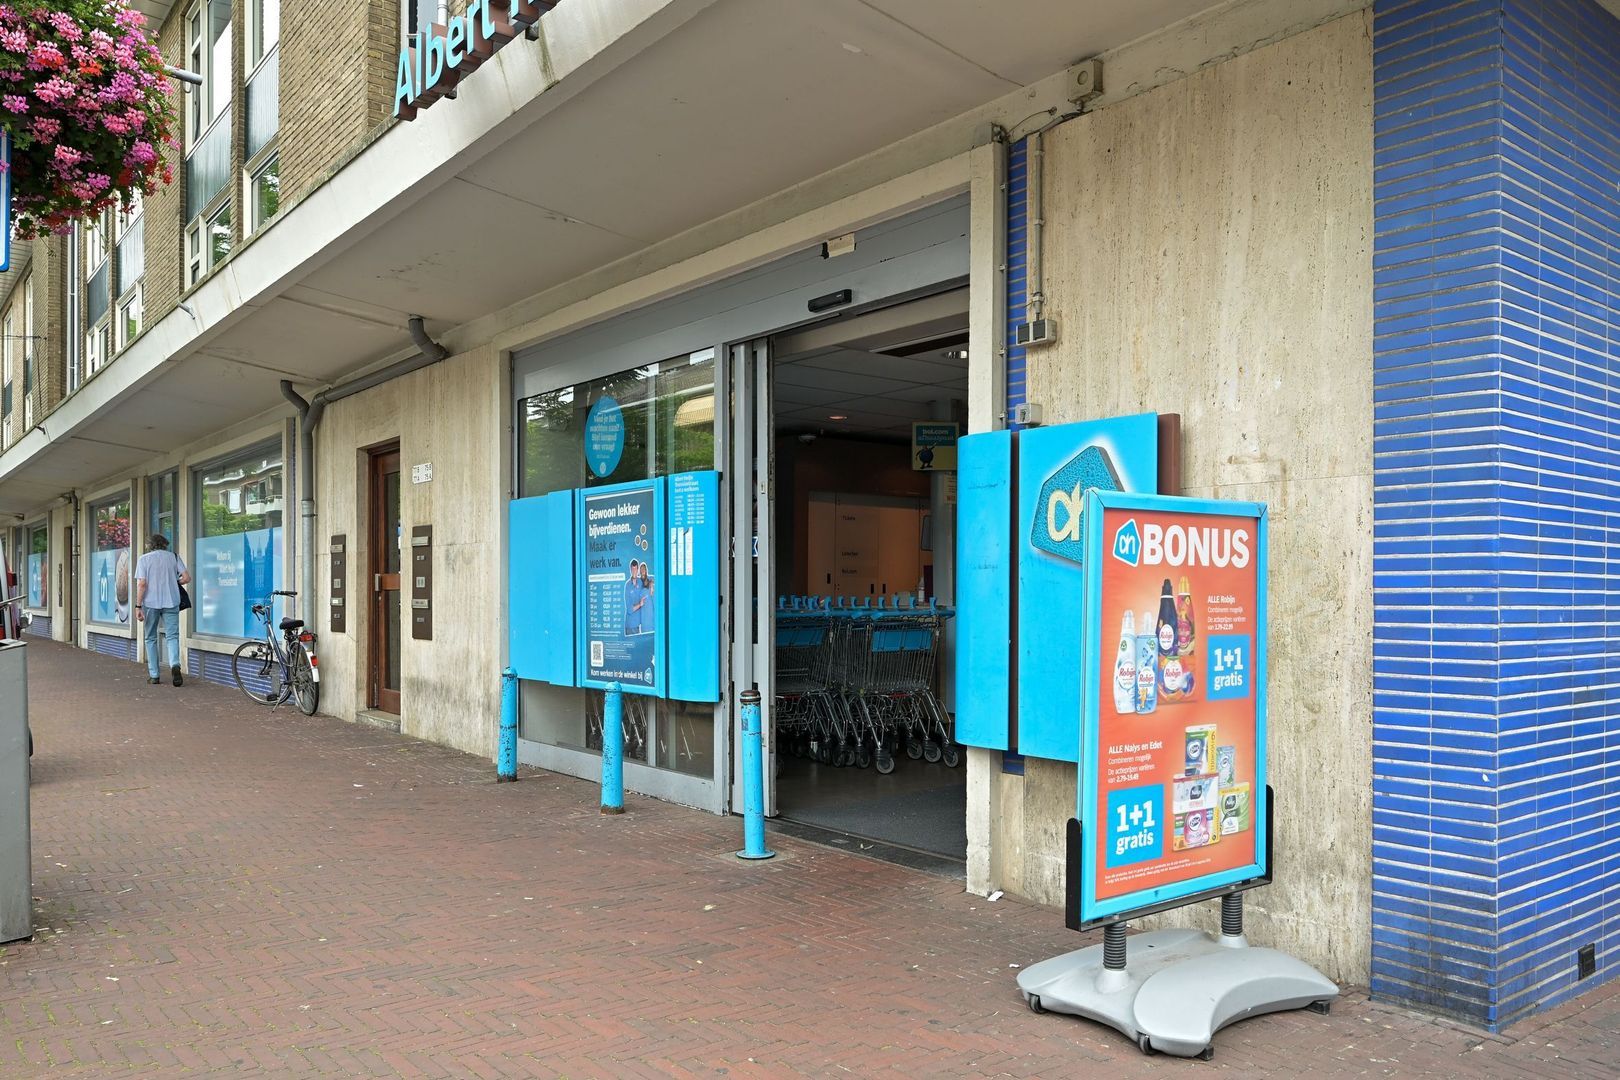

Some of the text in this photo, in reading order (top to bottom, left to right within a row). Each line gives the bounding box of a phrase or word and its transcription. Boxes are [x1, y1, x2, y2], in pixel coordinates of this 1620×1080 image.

[394, 0, 496, 118] Albert
[588, 502, 640, 521] Gewoon lekker
[588, 521, 632, 539] bijverdienen.
[590, 541, 617, 553] Maak er
[1143, 524, 1250, 568] BONUS
[590, 556, 622, 569] werk van.
[1208, 595, 1236, 605] ALLE Robijn
[1214, 647, 1244, 672] 1+1
[590, 669, 600, 677] Kom
[600, 670, 614, 678] werken
[624, 670, 638, 679] winkel
[1119, 667, 1136, 678] Robijn
[1139, 673, 1154, 683] Robijn
[1165, 667, 1181, 678] Robijn
[1214, 671, 1243, 691] gratis
[1108, 740, 1163, 755] ALLE Nalys en Edet
[1107, 768, 1115, 776] De
[1117, 799, 1156, 833] 1+1
[1115, 828, 1154, 855] gratis
